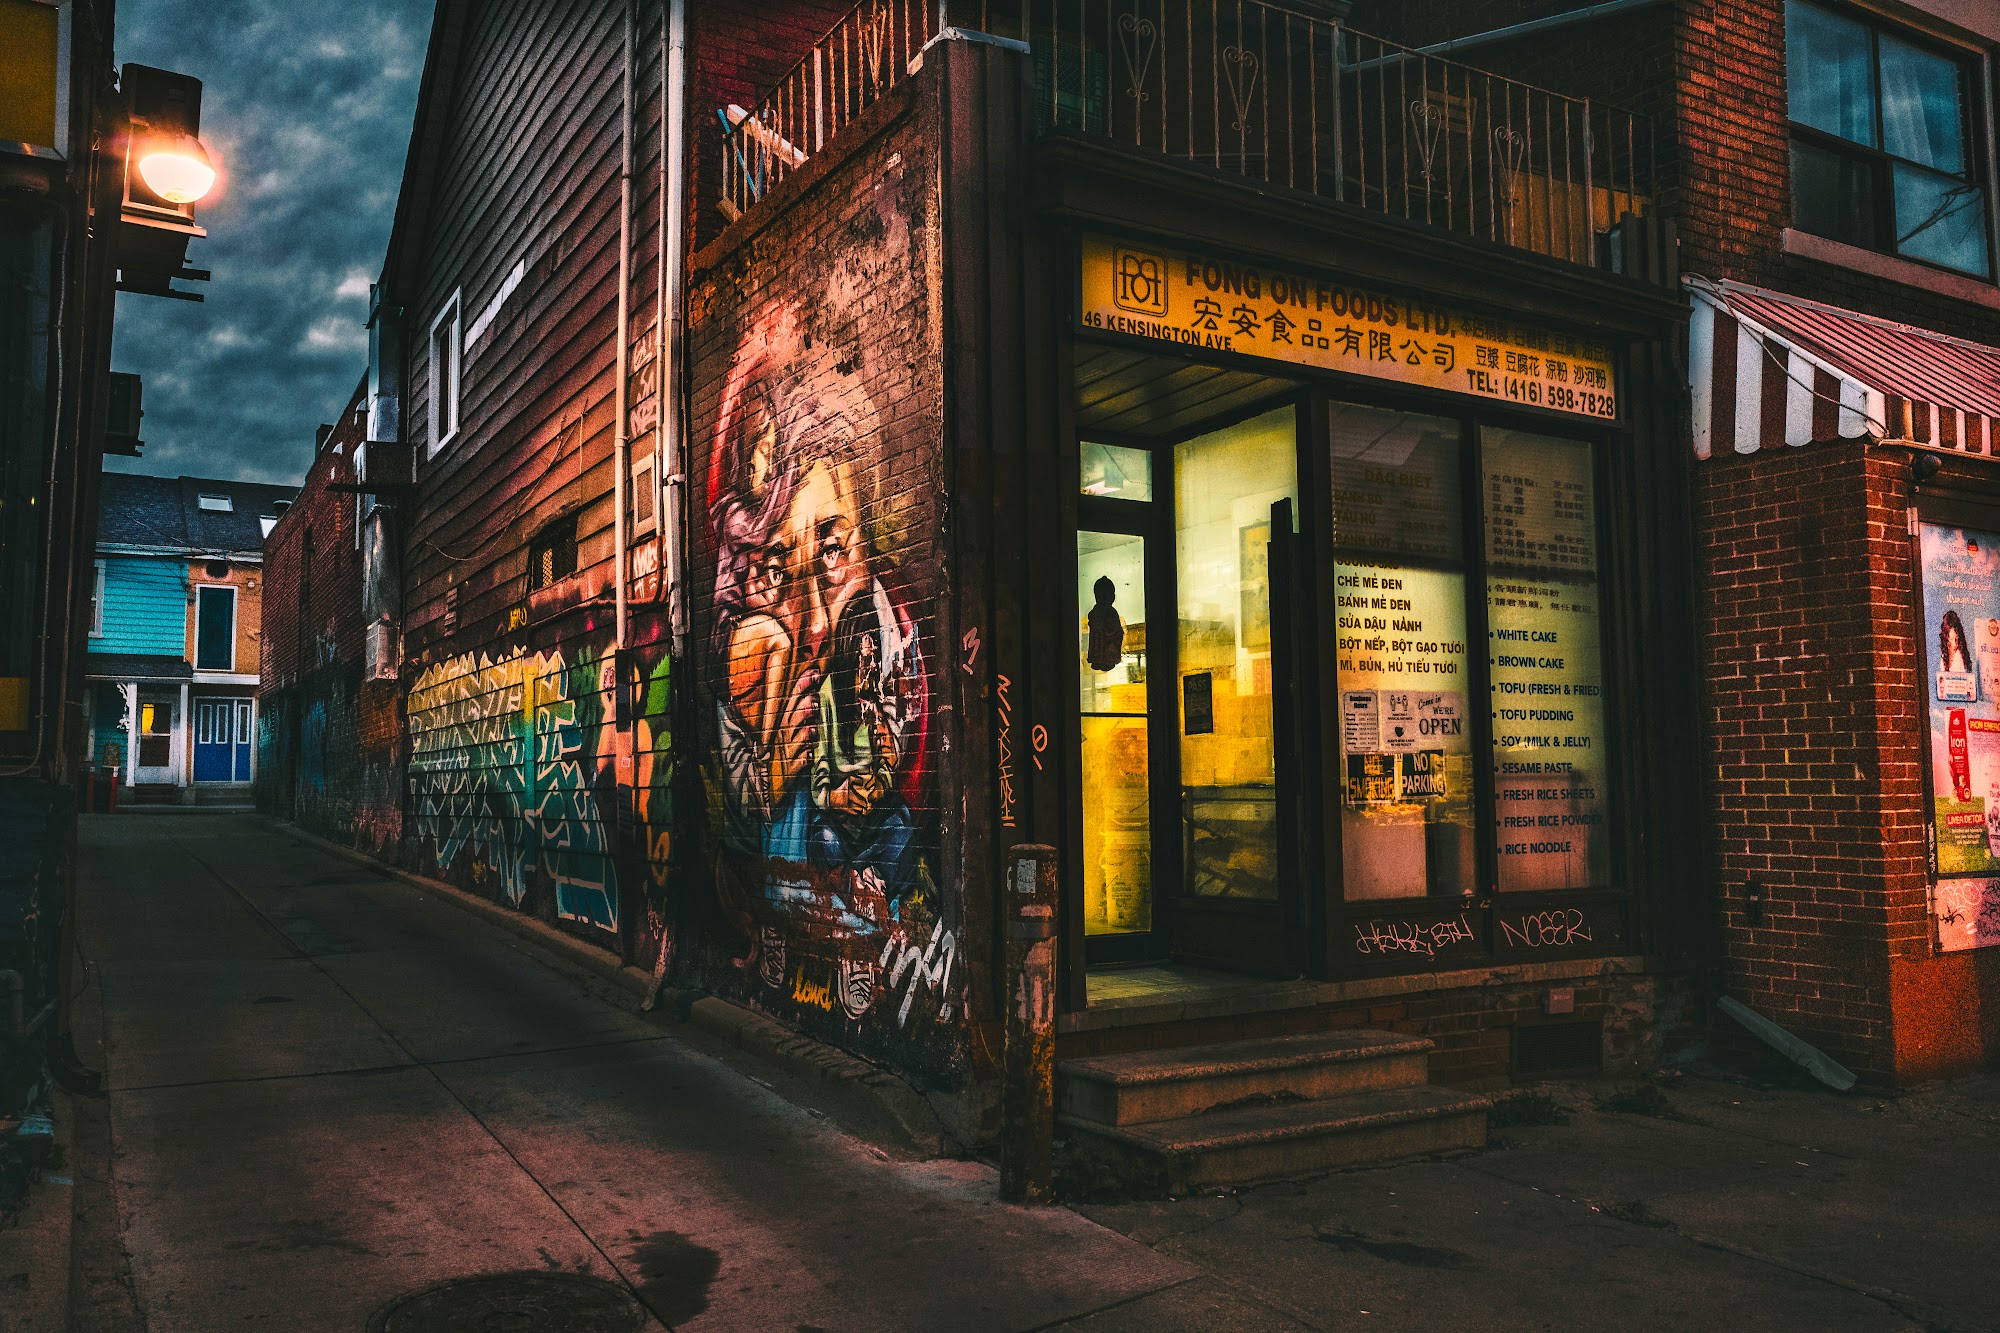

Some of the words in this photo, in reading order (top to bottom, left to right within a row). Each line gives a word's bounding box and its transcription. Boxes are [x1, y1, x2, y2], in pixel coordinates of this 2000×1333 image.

[1185, 256, 1262, 300] FONG
[1270, 276, 1312, 309] ON
[1316, 284, 1399, 328] FOODS
[1406, 303, 1457, 339] LTD.
[1084, 311, 1101, 327] 46
[1107, 314, 1201, 346] KENSINGTON
[1205, 333, 1237, 352] AVE.
[1190, 296, 1457, 374] 宏安食品有限公司
[1475, 344, 1500, 370] 豆漿
[1505, 350, 1541, 378] 豆腐花
[1573, 364, 1606, 390] 沙河粉
[1466, 368, 1499, 394] TEL:
[1504, 375, 1542, 403] (416)
[1337, 593, 1368, 609] BÁNH
[1497, 629, 1529, 642] WHITE
[1531, 630, 1558, 643] CAKE
[1339, 637, 1362, 652] BỘT
[1364, 636, 1389, 653] NẾP,
[1392, 638, 1414, 655] BỘT
[1416, 641, 1438, 655] GẠO
[1498, 655, 1536, 669] BROWN
[1538, 657, 1565, 669] CAKE
[1499, 682, 1527, 696] TOFU
[1528, 682, 1562, 697] (FRESH
[1564, 684, 1571, 696] &
[1572, 684, 1603, 698] FRIED)
[1500, 709, 1527, 721] TOFU
[1530, 710, 1574, 721] PUDDING
[1419, 718, 1462, 736] OPEN
[1501, 736, 1522, 748] SOY
[1524, 735, 1552, 748] (MILK
[1553, 737, 1561, 747] &
[1562, 735, 1591, 749] JELLY)
[1950, 736, 1966, 749] Iron
[1413, 753, 1429, 772] NO
[1502, 762, 1542, 774] SESAME
[1544, 762, 1573, 773] PASTE
[1401, 773, 1444, 794] PARKING
[1503, 789, 1535, 801] FRESH
[1538, 789, 1558, 800] RICE
[1560, 788, 1595, 800] SHEETS
[1504, 816, 1535, 828] FRESH
[1538, 815, 1559, 827] RICE
[1561, 814, 1604, 826] POWDER
[1947, 814, 1964, 826] LIVER
[1506, 843, 1528, 855] RICE
[1530, 842, 1571, 854] NOODLE
